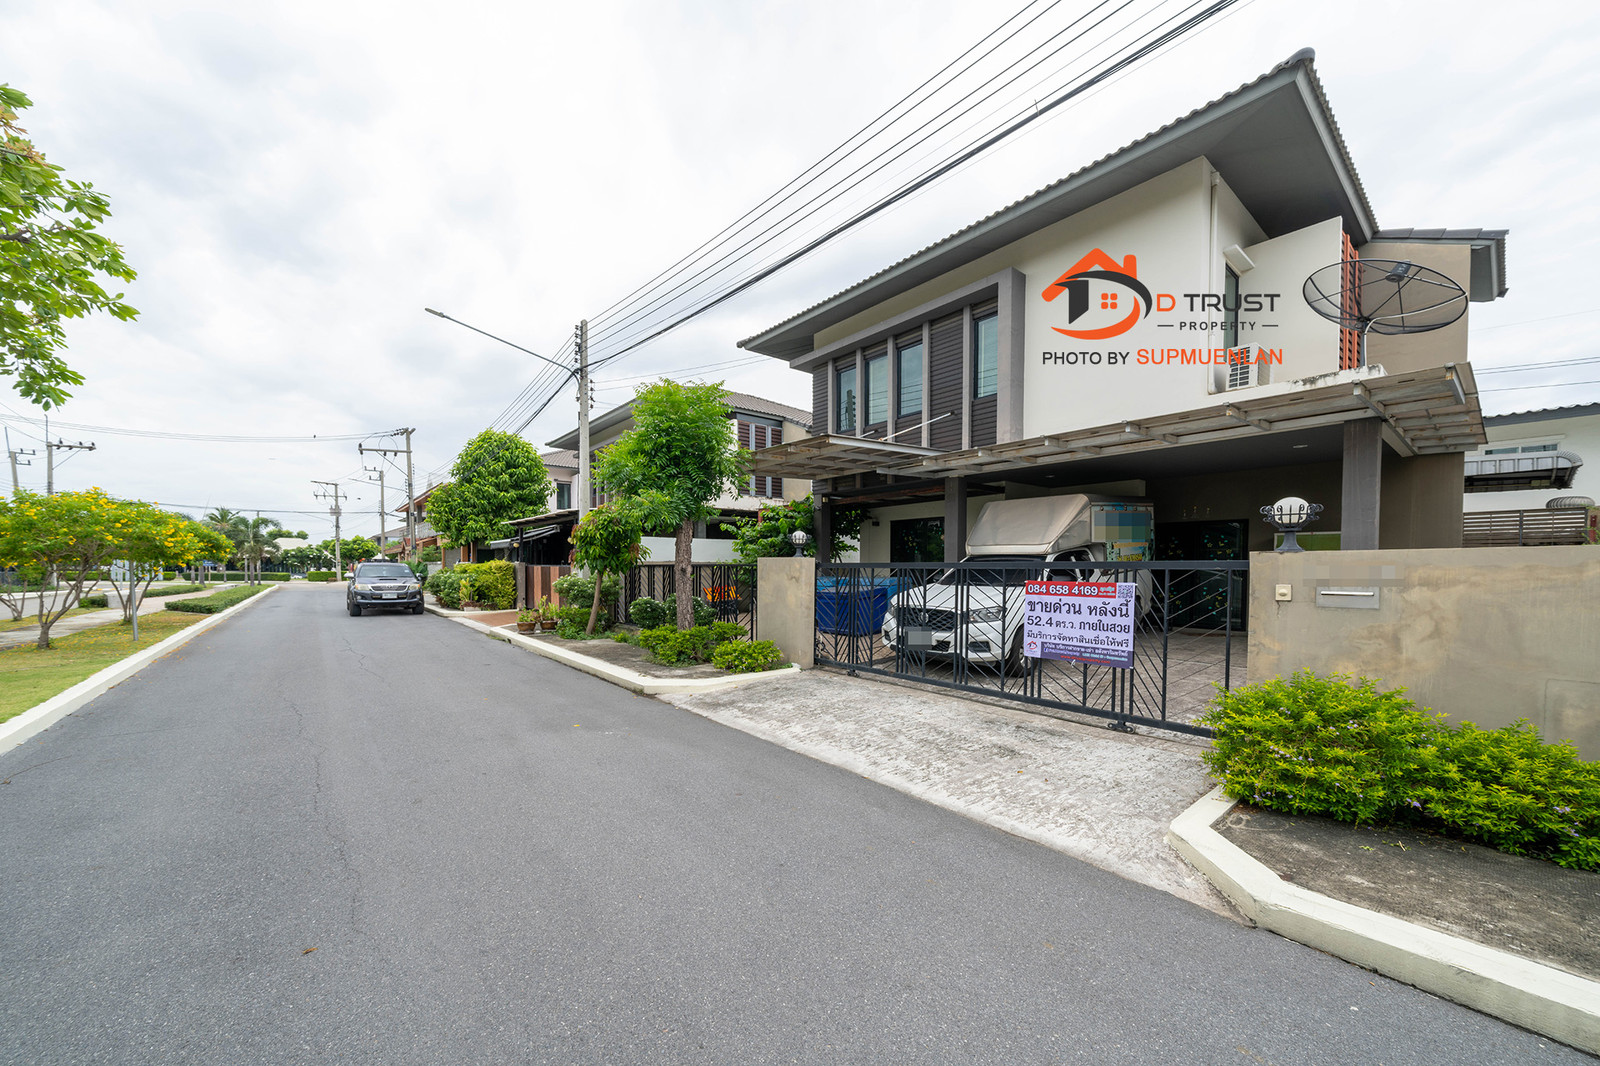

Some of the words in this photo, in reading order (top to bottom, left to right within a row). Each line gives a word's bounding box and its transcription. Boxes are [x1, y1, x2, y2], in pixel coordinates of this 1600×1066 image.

[1027, 584, 1047, 594] 084
[1049, 585, 1069, 595] 658
[1071, 586, 1098, 595] 4169
[1027, 598, 1082, 615] ขายด่วน
[1087, 599, 1131, 618] หลังนี้
[1027, 616, 1053, 627] 52.4
[1055, 621, 1076, 630] ตร.ว.
[1079, 619, 1130, 634] ภายในสวย
